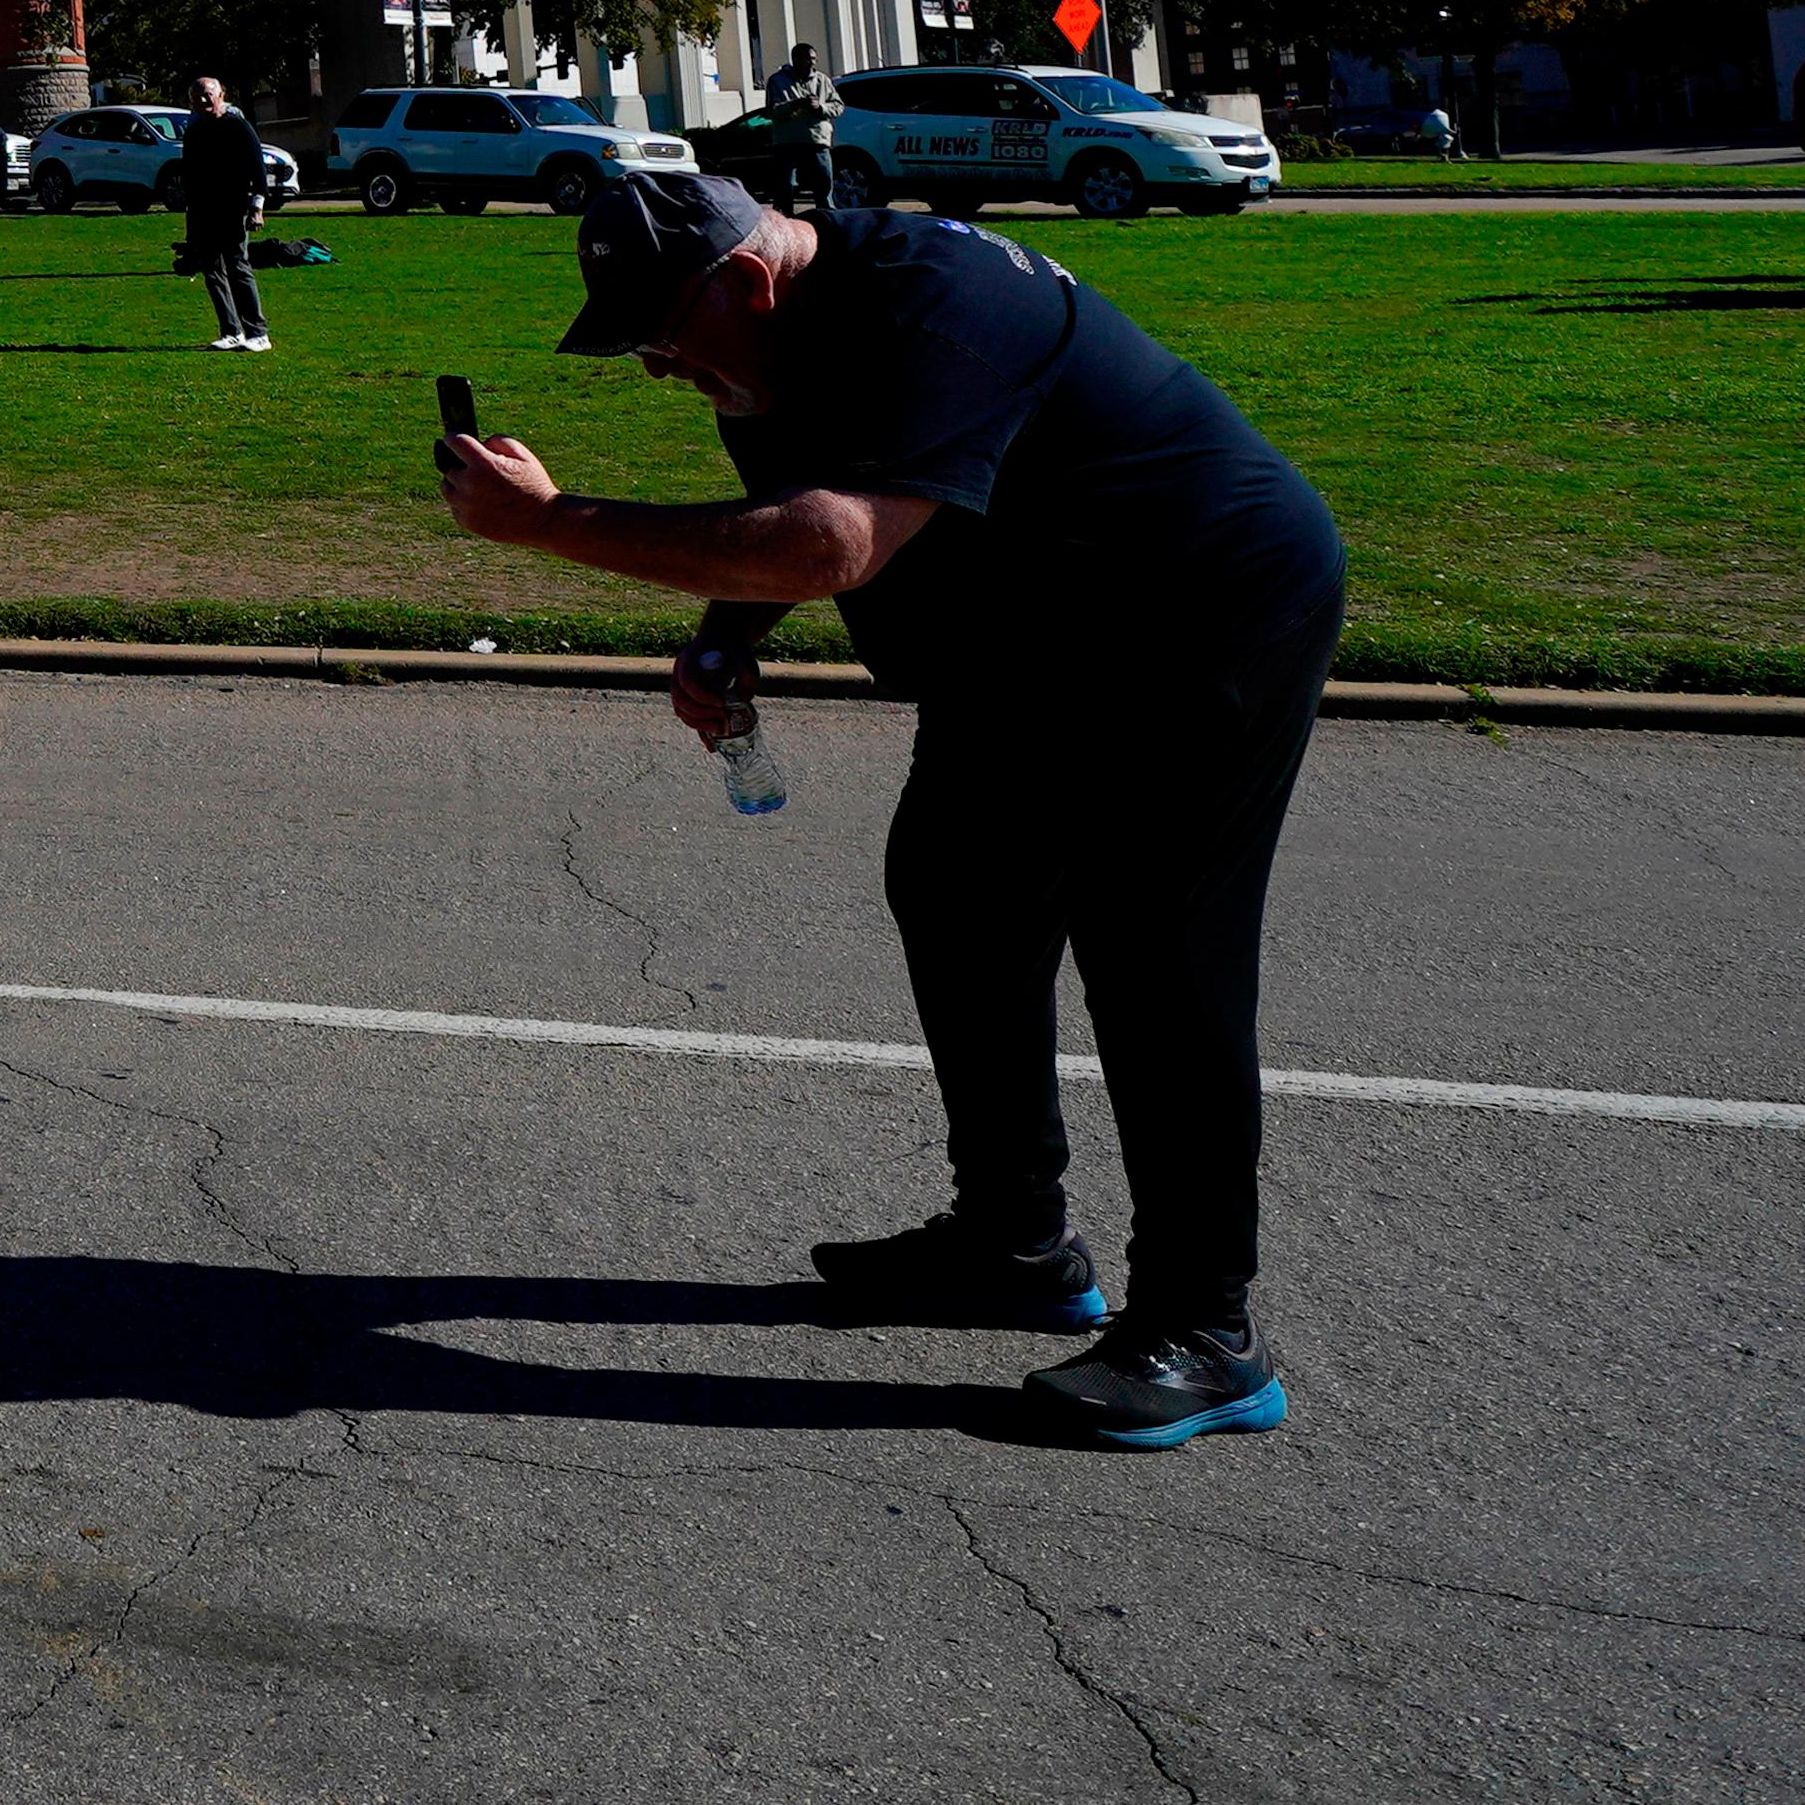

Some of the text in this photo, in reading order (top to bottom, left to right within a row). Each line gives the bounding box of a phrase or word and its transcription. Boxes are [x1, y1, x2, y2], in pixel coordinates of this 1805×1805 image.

[993, 122, 1047, 135] KRLD
[894, 136, 923, 155] ALL
[929, 137, 981, 156] NEWS
[993, 145, 1046, 158] 1080
